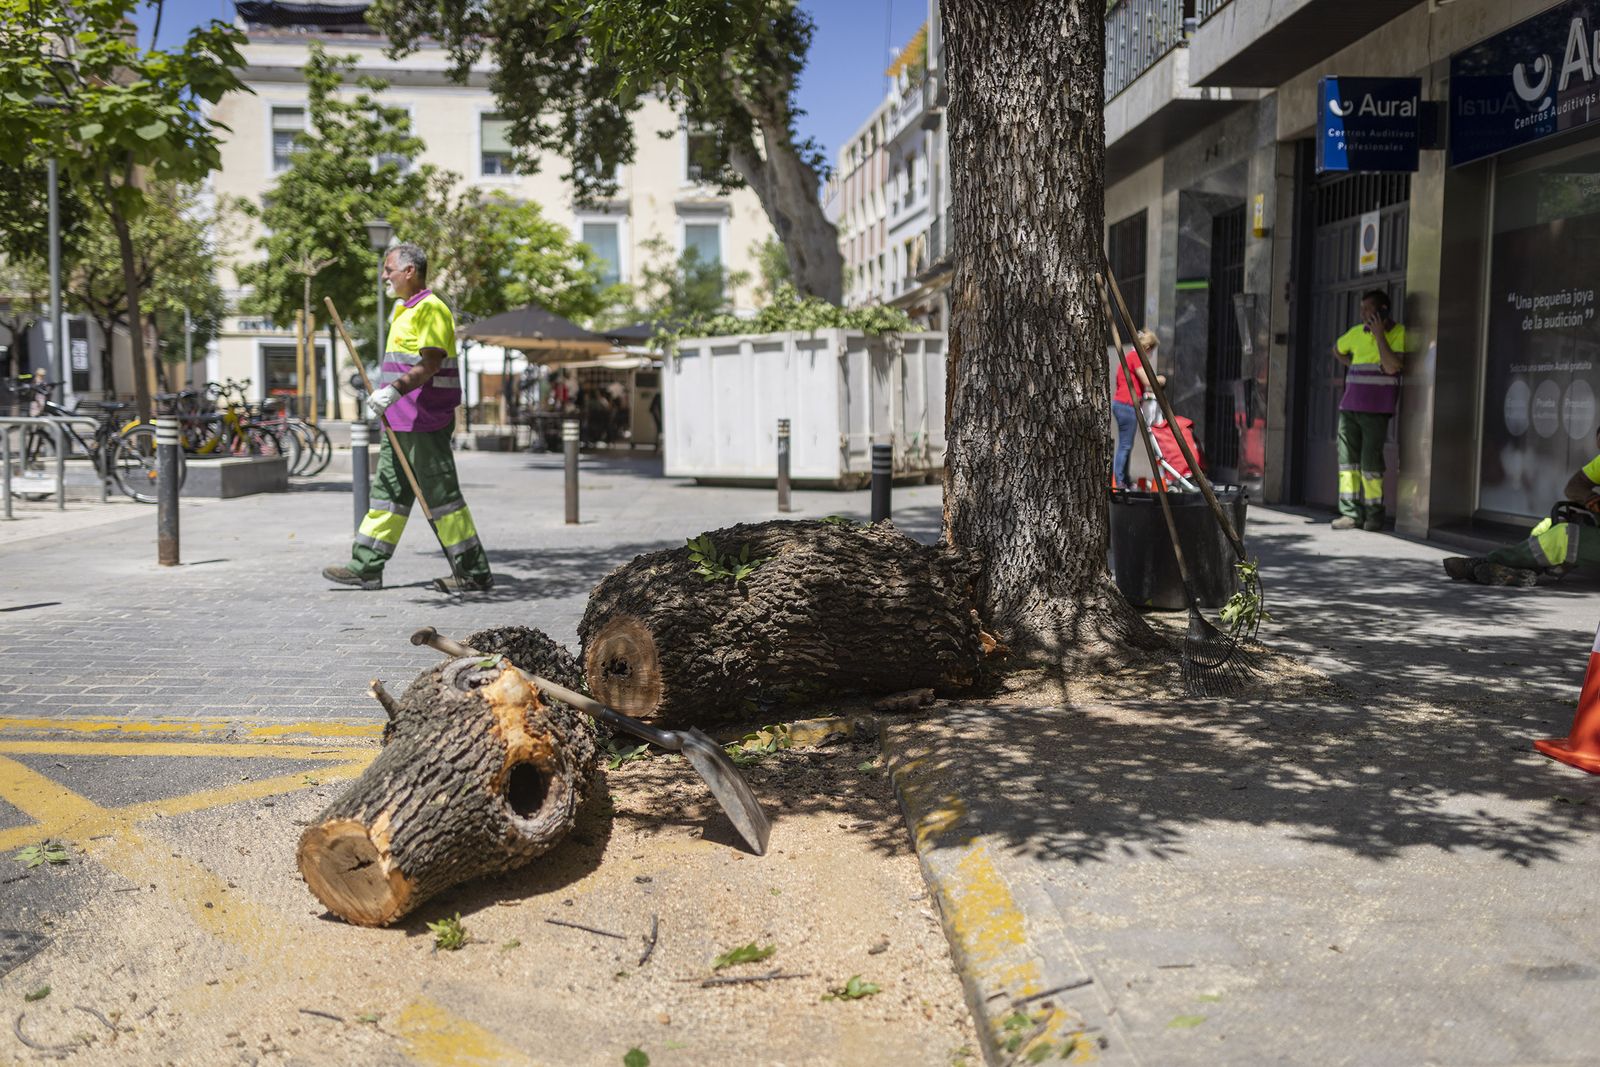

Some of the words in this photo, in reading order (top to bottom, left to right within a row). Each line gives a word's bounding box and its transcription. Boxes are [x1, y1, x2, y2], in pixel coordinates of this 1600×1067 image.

[1358, 92, 1418, 118] Aural
[1514, 111, 1548, 130] Centros
[1551, 93, 1596, 116] Auditivos
[1327, 127, 1367, 138] Centros
[1369, 128, 1417, 138] Auditivos
[1336, 141, 1404, 151] Profesionales
[1533, 288, 1572, 311] pequeña
[1573, 288, 1594, 307] joya
[1522, 315, 1533, 331] de
[1534, 314, 1543, 330] la
